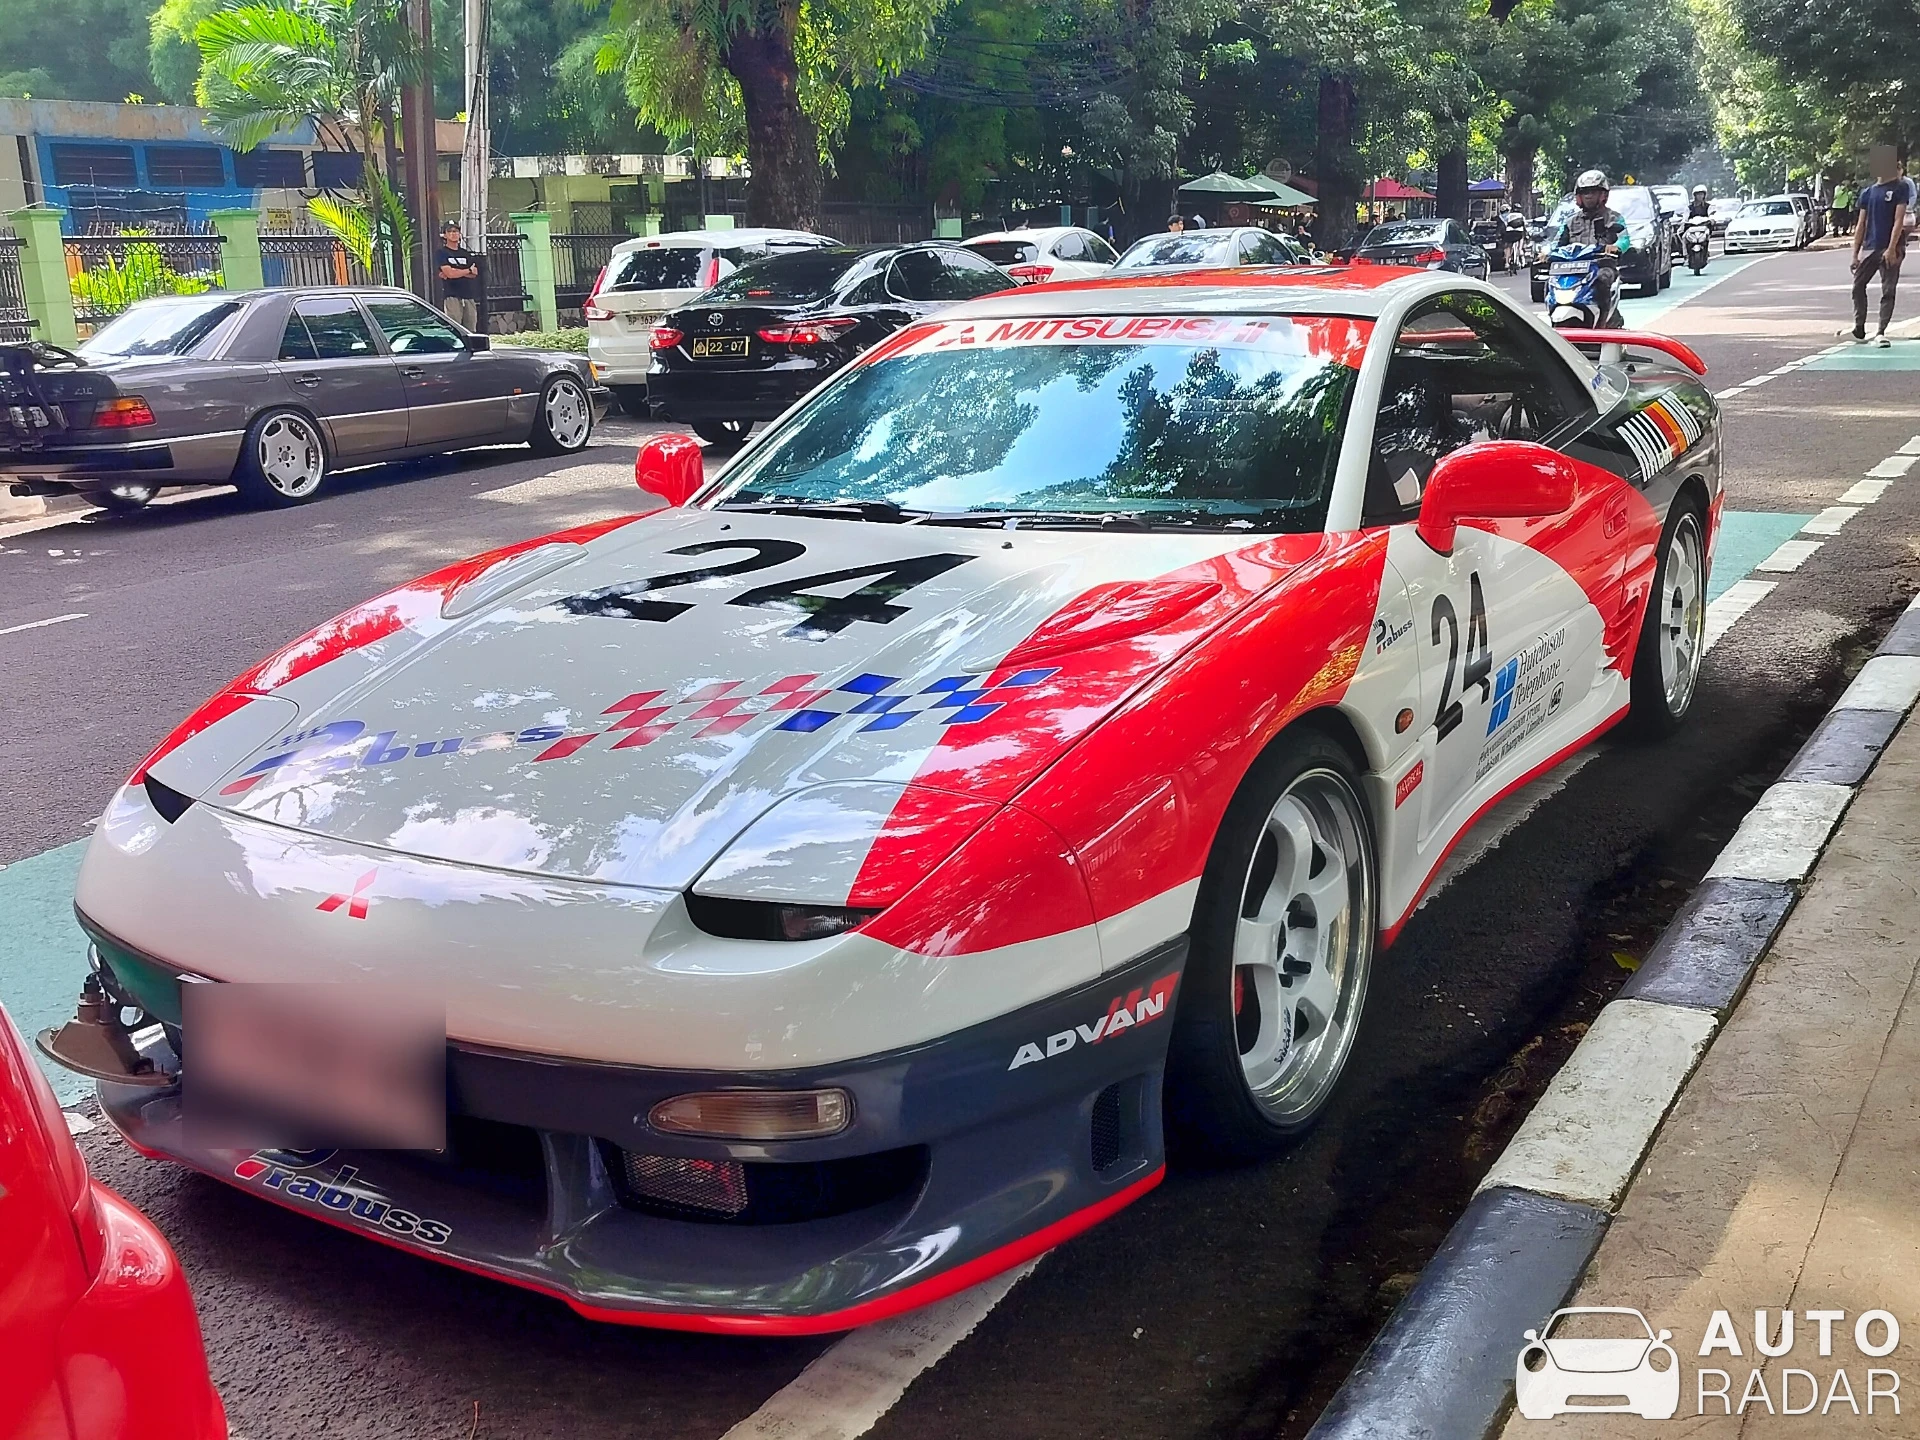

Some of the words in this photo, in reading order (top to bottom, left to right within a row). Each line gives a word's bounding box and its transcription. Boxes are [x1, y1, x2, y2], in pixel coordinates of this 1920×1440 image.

[985, 318, 1270, 344] MITSUBISHI
[554, 538, 981, 643] 24
[1430, 570, 1492, 746] 24
[1513, 658, 1561, 710] Telephone
[1518, 628, 1565, 680] Hutchison
[1007, 991, 1164, 1071] ADVAN
